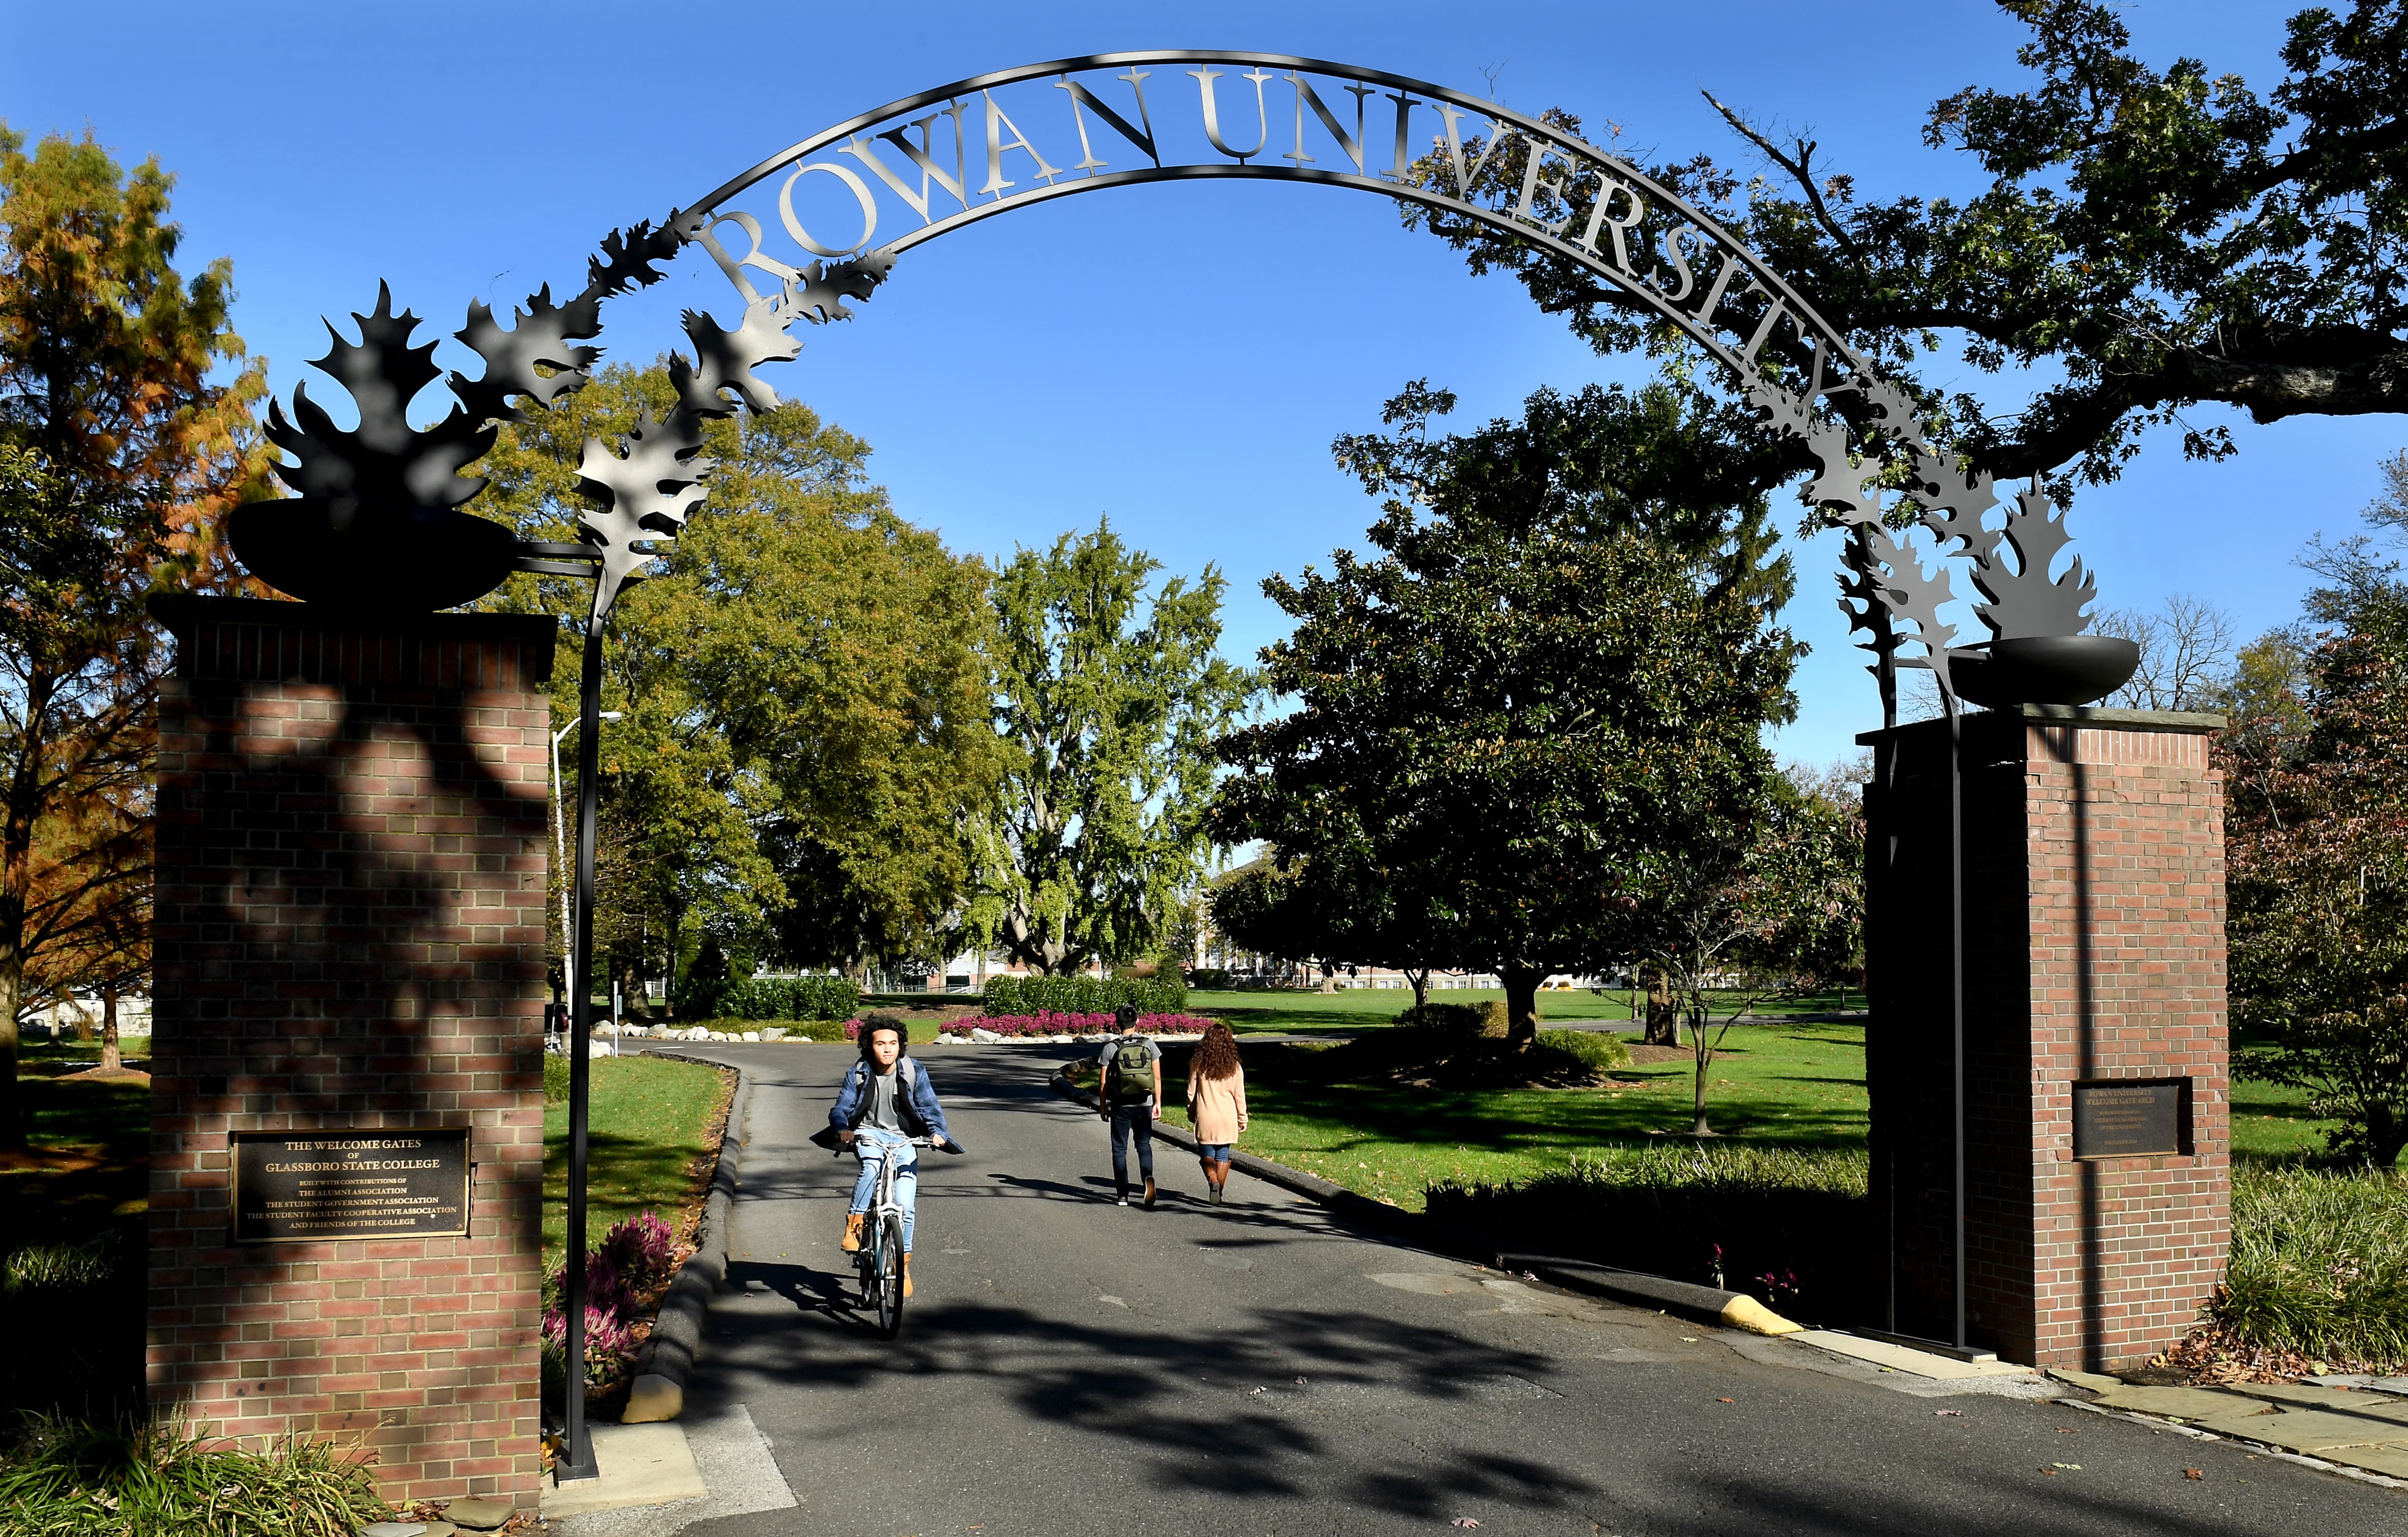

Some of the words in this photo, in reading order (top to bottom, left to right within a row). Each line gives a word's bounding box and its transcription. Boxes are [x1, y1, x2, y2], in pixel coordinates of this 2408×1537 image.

[691, 70, 1158, 306] ROWAN
[1186, 69, 1864, 409] UNIVERSITY
[284, 1142, 312, 1151] THE
[314, 1140, 380, 1150] WELCOME
[382, 1139, 422, 1149] GATES
[265, 1162, 339, 1172] GLASSBORO
[342, 1161, 380, 1170] STATE
[382, 1159, 440, 1169] COLLEGE
[324, 1198, 384, 1206] GOVERNMENT
[384, 1197, 439, 1205] ASSOCIATION
[343, 1208, 402, 1217] COOPERATIVE
[402, 1206, 457, 1215] ASSOCIATION
